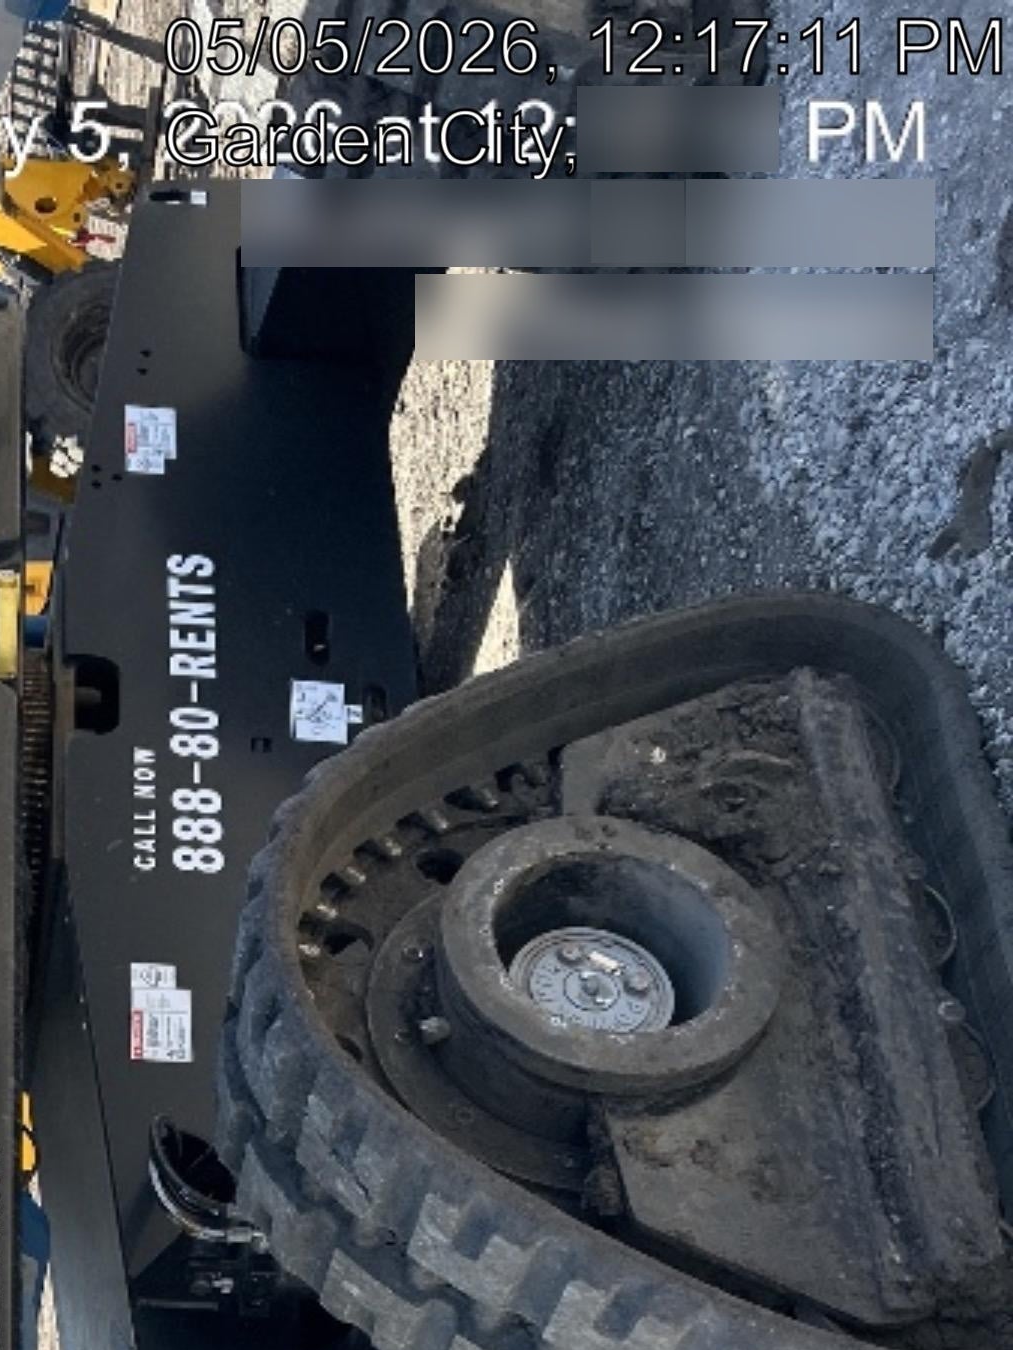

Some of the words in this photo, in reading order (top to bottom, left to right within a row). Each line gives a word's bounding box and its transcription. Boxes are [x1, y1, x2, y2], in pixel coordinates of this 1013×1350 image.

[166, 553, 225, 874] 888-80-RENTS
[133, 746, 157, 799] NOW
[133, 809, 157, 871] CALL
